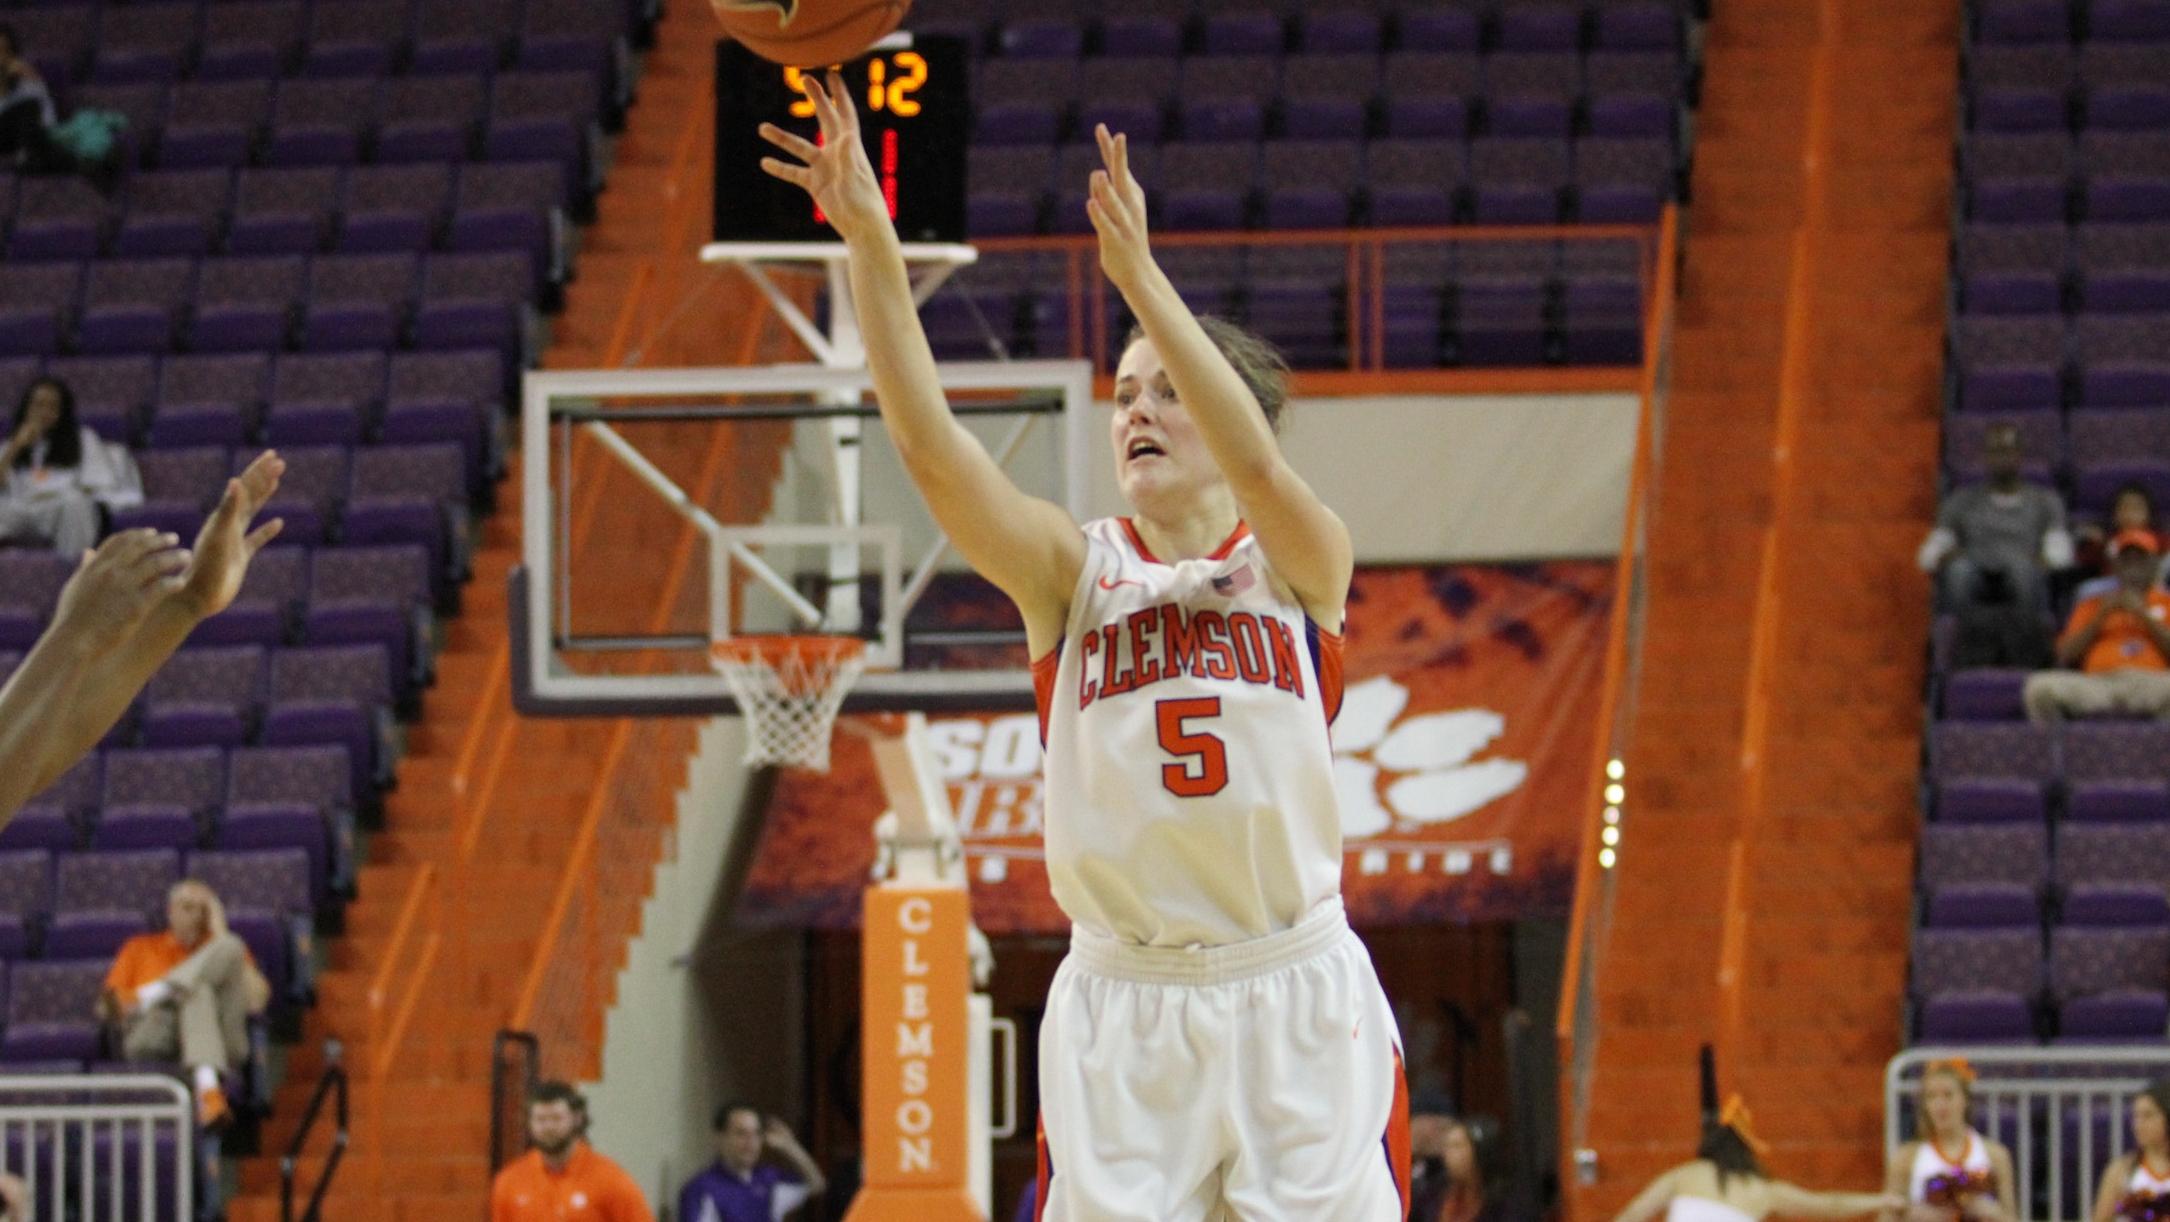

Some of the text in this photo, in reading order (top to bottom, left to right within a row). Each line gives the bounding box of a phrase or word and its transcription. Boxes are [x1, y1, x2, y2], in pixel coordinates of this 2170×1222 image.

[1079, 602, 1305, 712] CLEMSON
[1155, 696, 1229, 798] 5
[896, 897, 934, 1174] CLEMSON
